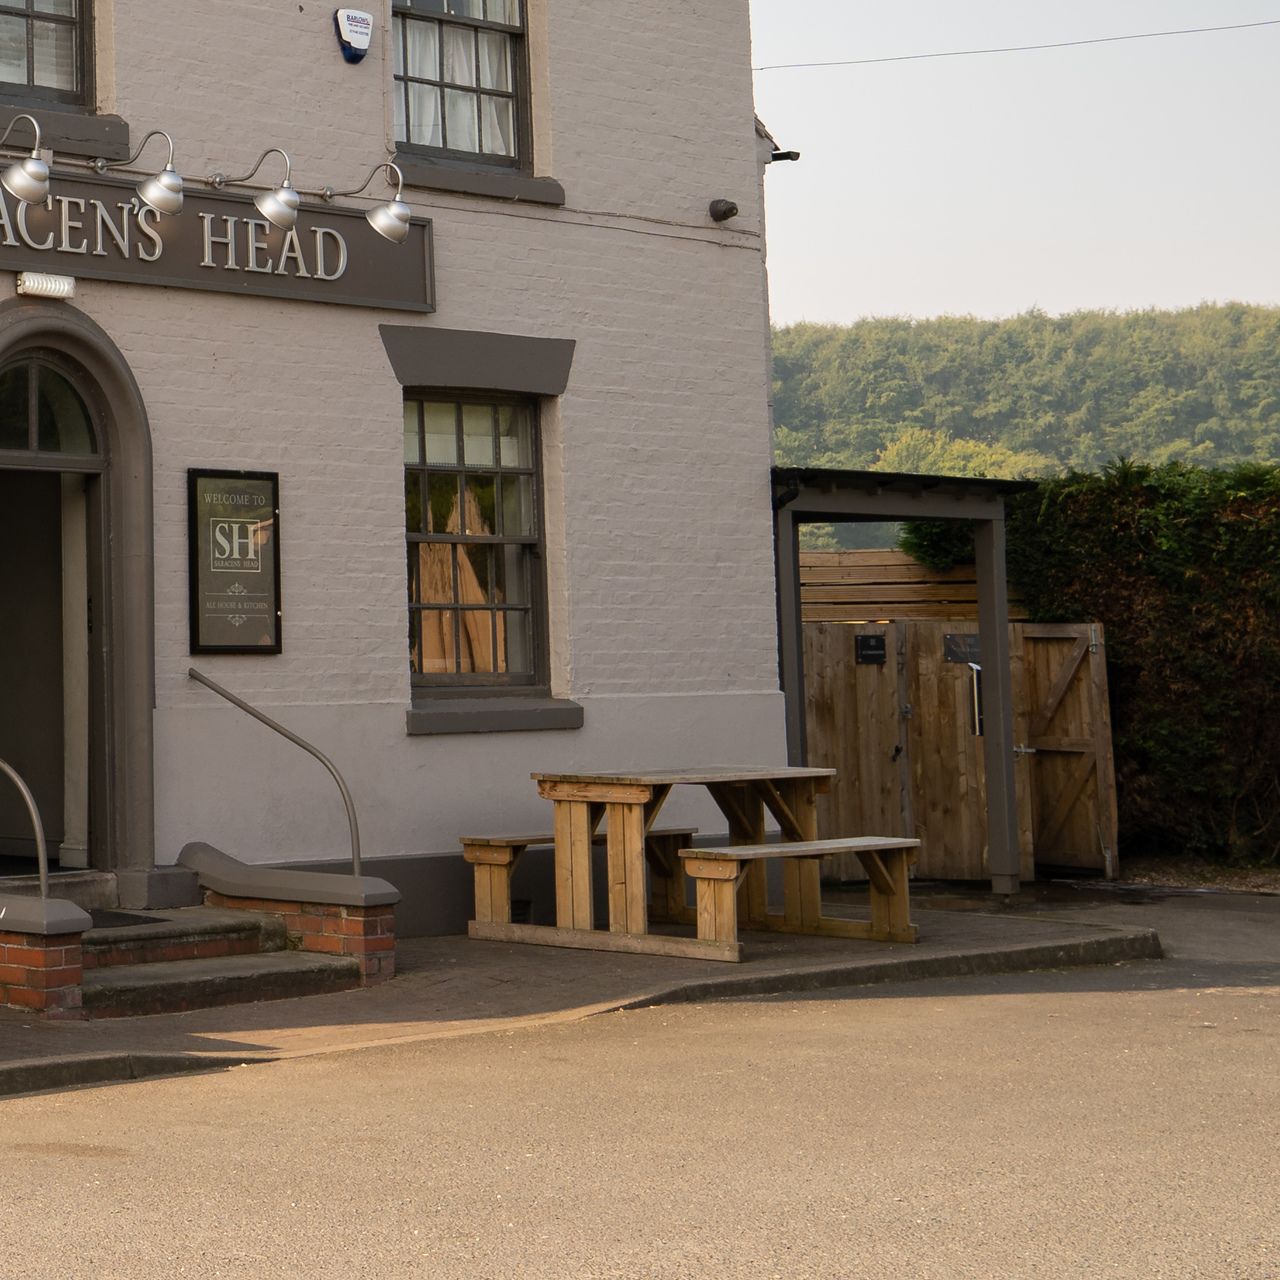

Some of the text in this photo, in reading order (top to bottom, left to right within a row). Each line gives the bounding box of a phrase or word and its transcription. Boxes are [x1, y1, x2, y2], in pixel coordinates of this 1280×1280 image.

[198, 212, 348, 281] HEAD
[204, 493, 266, 506] WELCOME TO
[215, 522, 257, 559] SH
